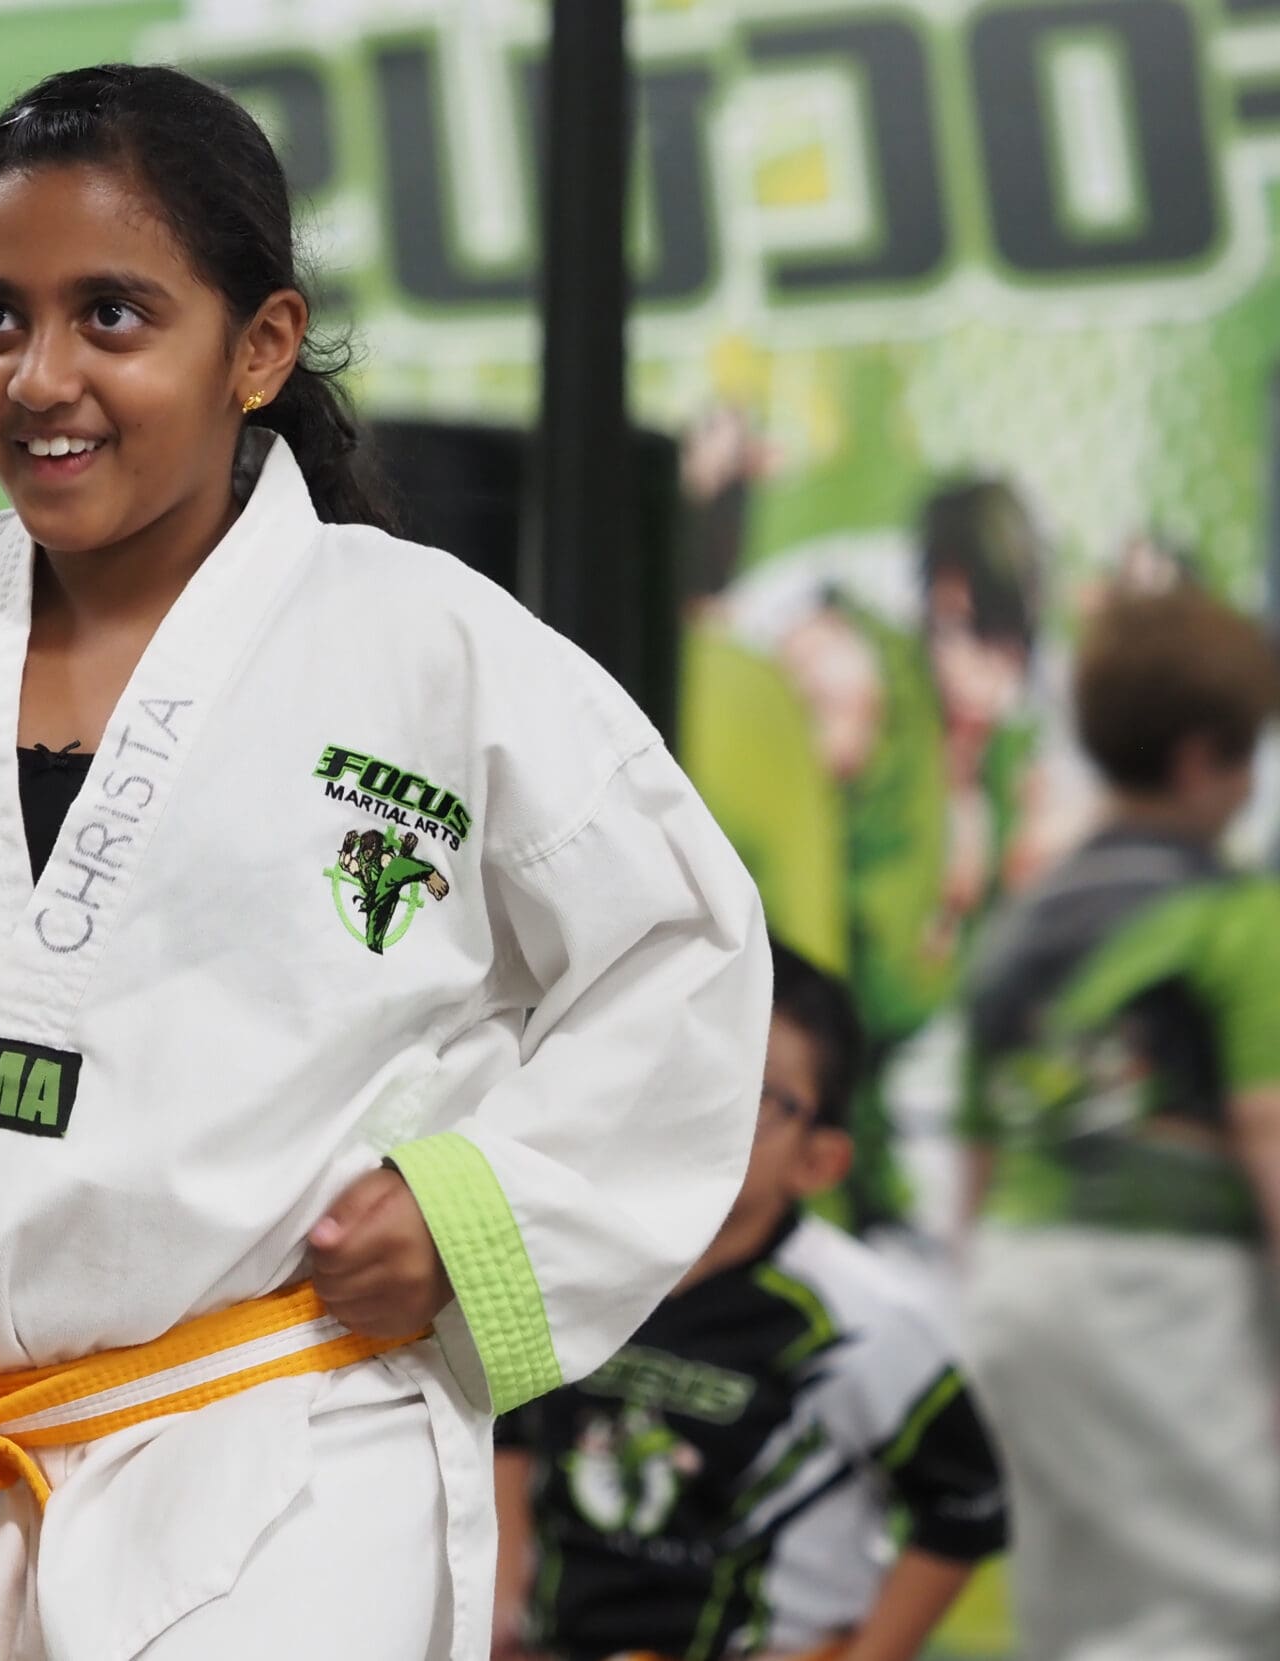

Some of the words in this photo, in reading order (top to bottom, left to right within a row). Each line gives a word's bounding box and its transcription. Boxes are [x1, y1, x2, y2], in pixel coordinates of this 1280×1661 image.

[34, 699, 194, 953] CHRISTA
[313, 744, 472, 842] FOCUS
[324, 781, 411, 828] MARTIAL
[414, 816, 461, 852] ARTS
